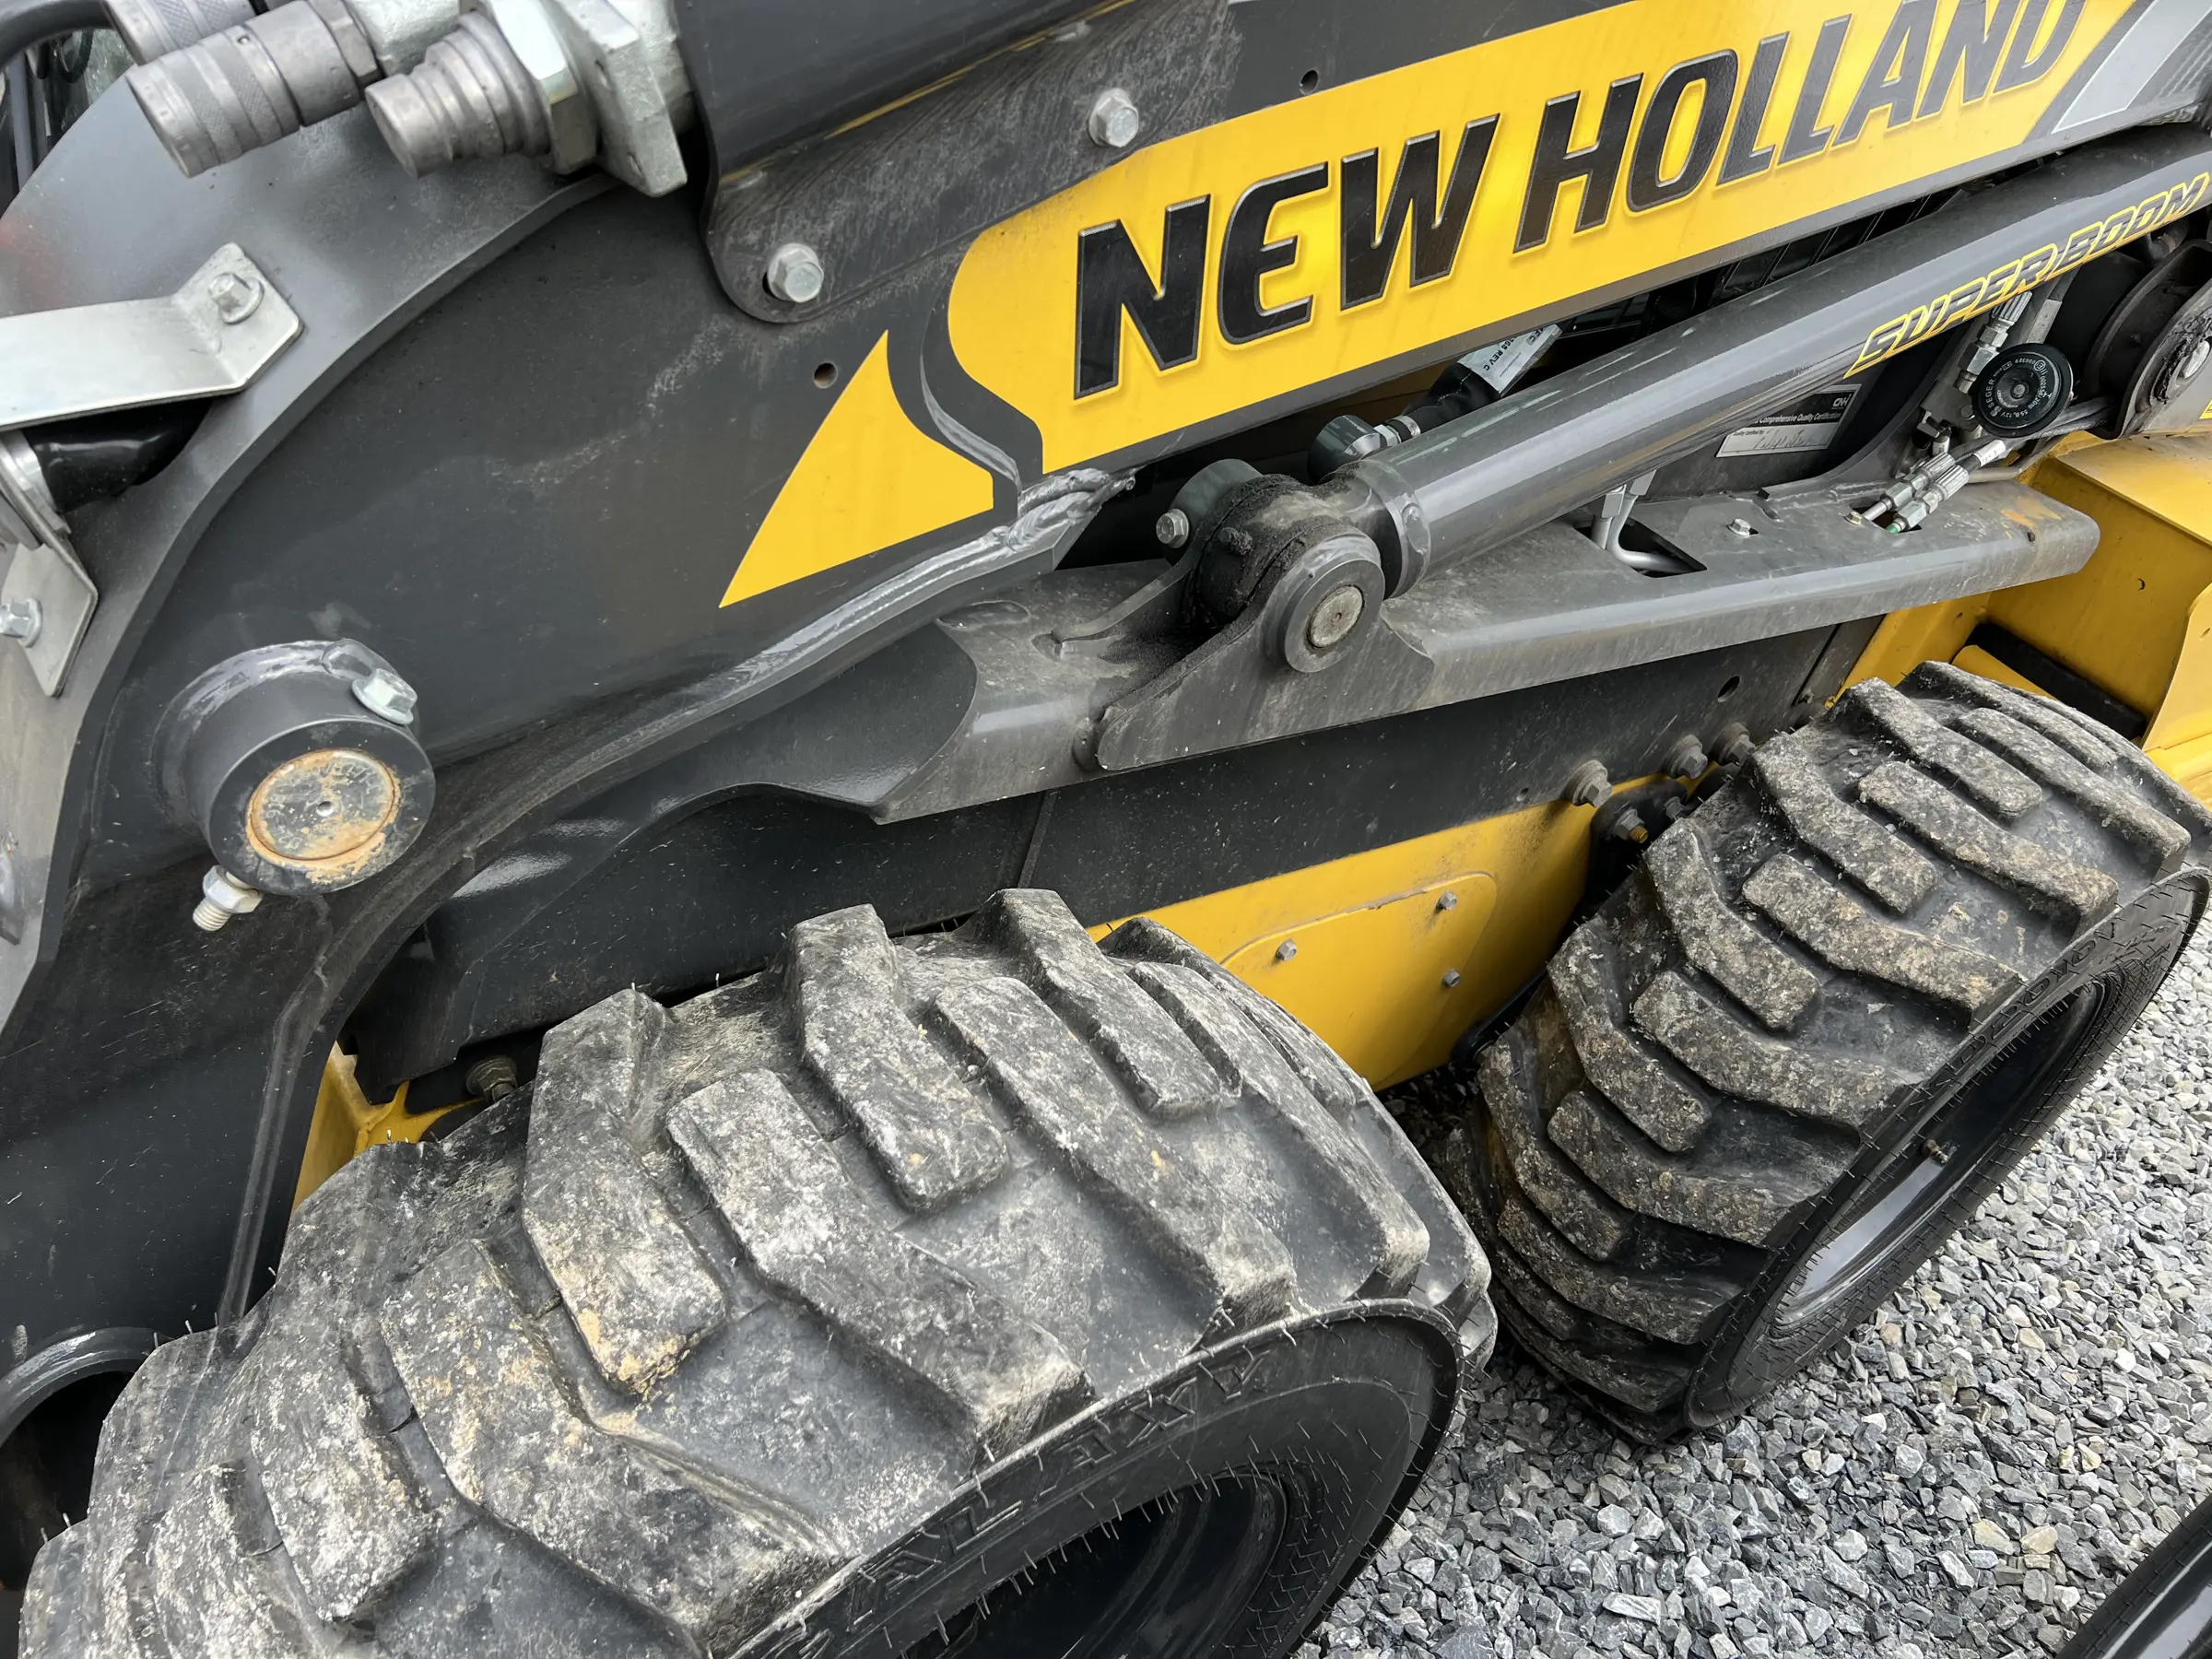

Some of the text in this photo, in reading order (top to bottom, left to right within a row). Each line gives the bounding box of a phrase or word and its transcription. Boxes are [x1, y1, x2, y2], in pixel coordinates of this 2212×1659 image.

[1075, 0, 2086, 400] NEW HOLLAND
[1985, 379, 1996, 407] SEGER
[1759, 415, 1797, 425] Comprehensive
[1797, 413, 1814, 423] Quality
[1814, 411, 1841, 421] Certification
